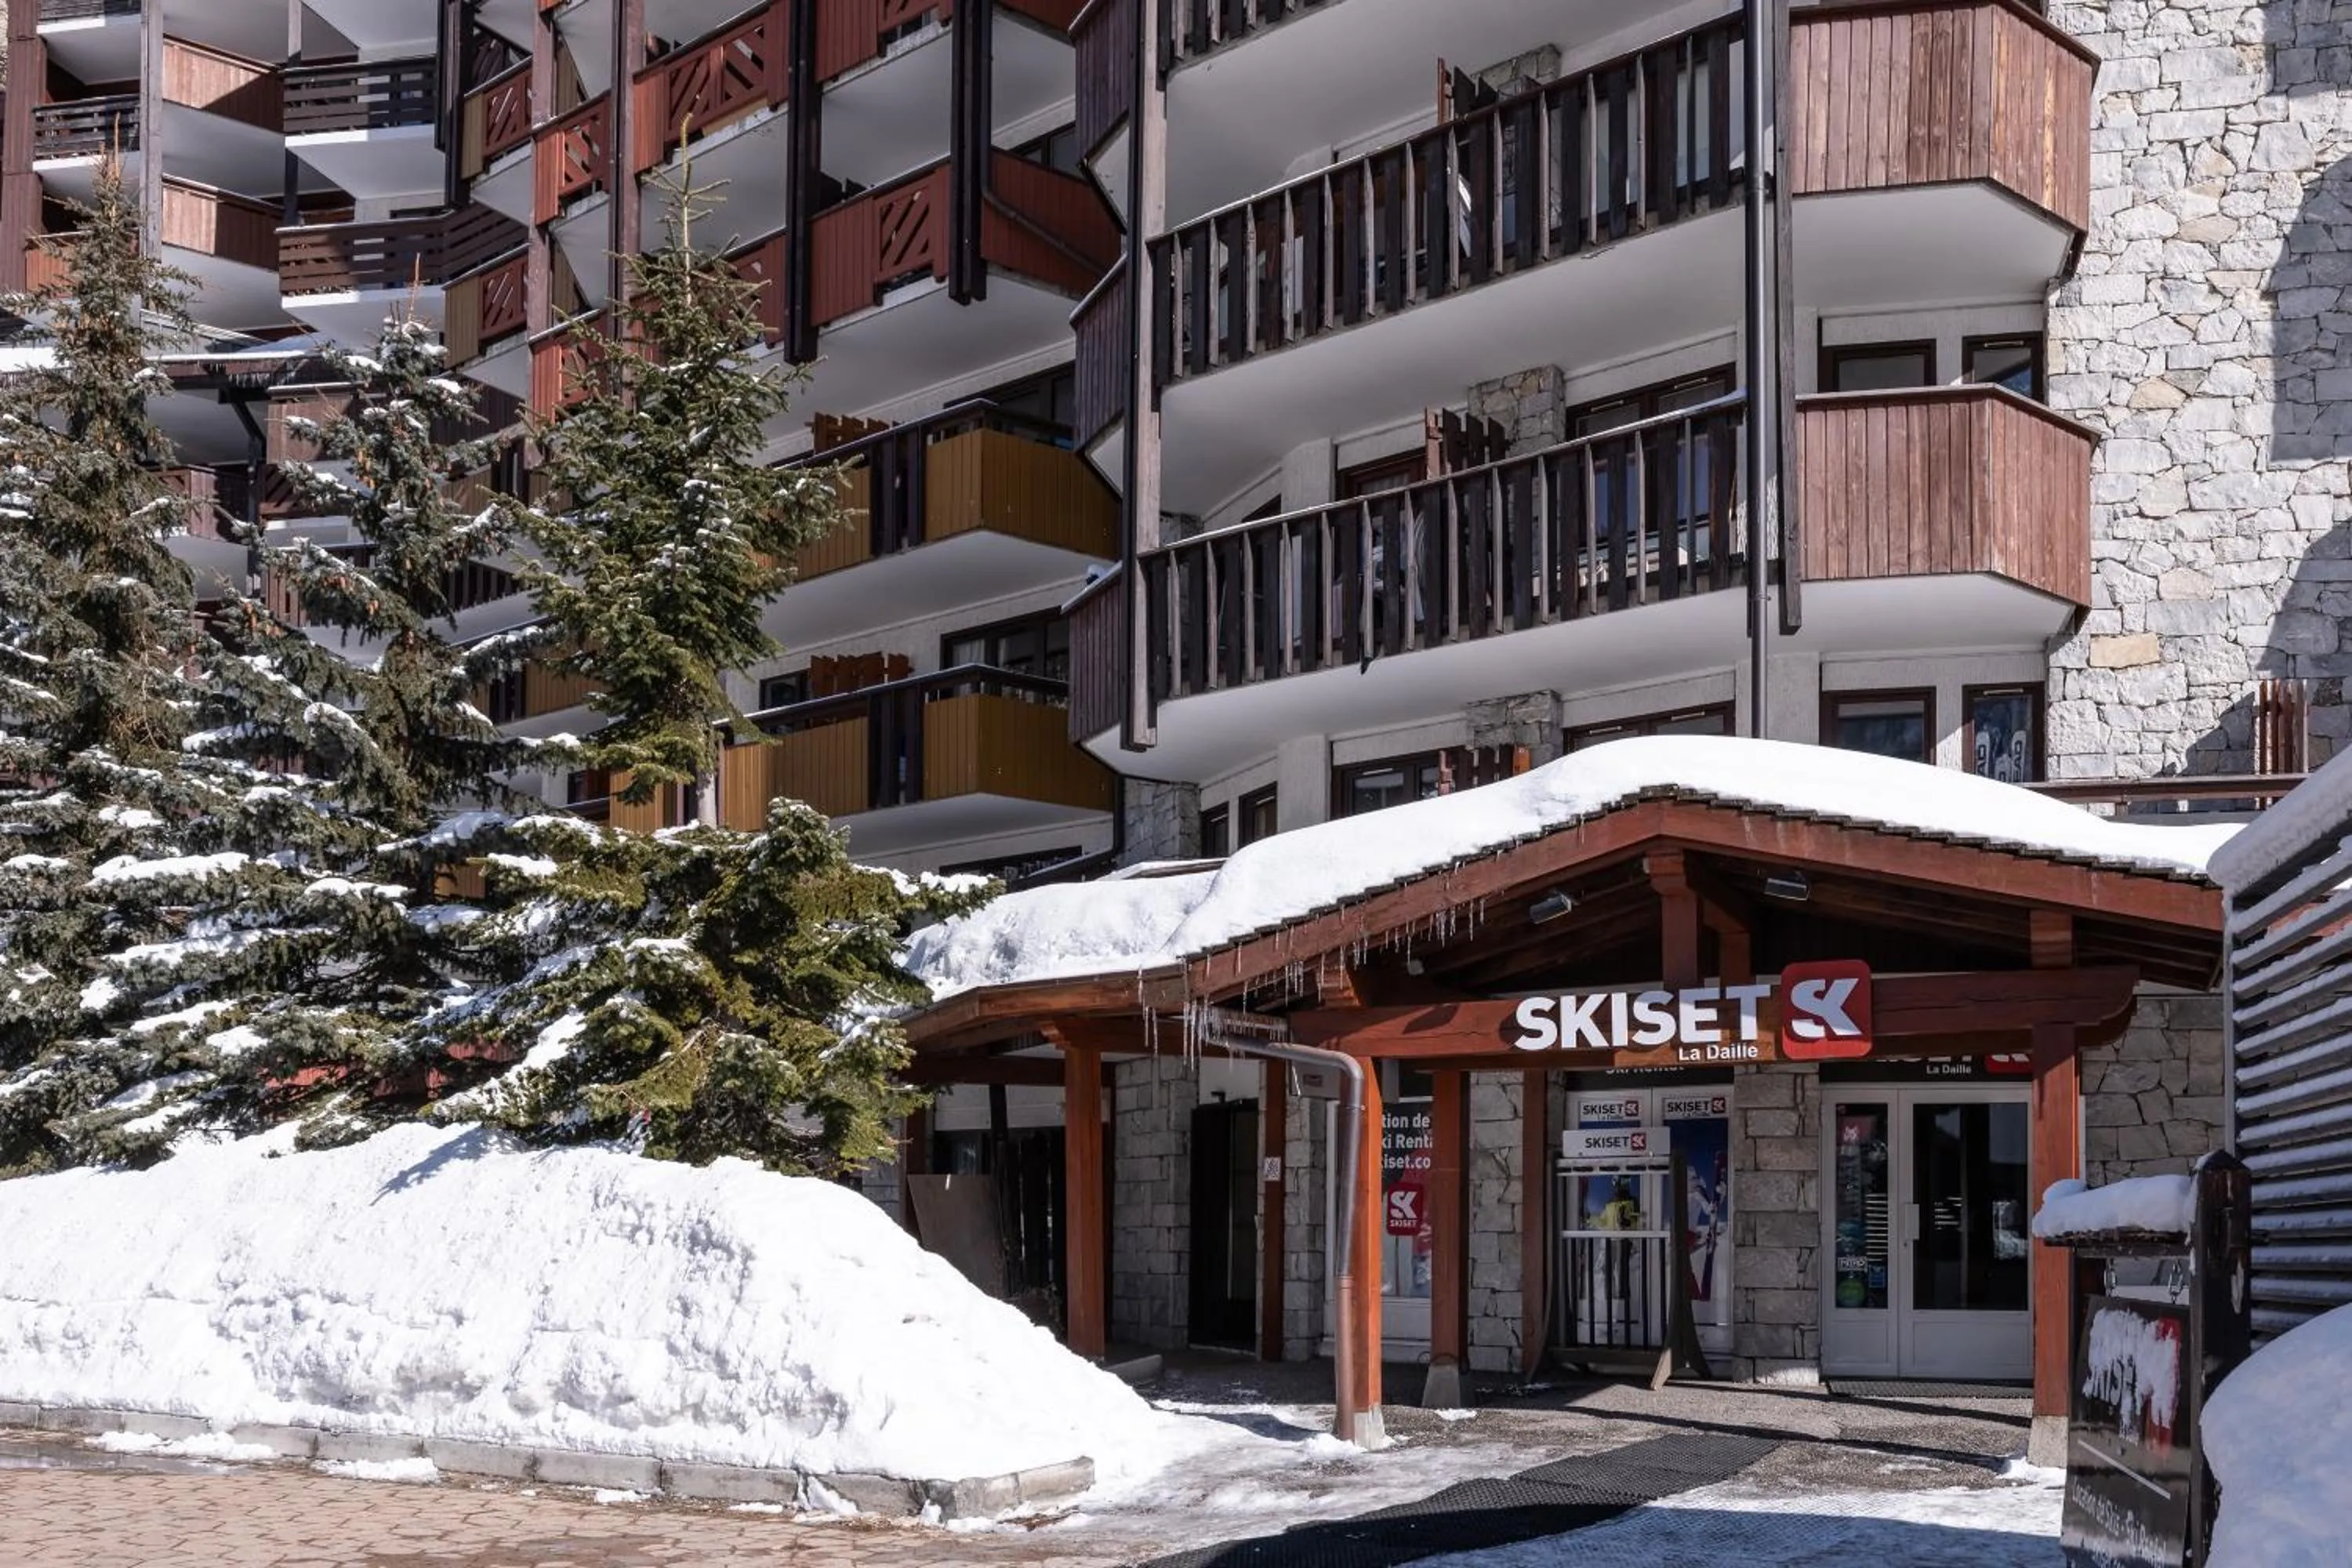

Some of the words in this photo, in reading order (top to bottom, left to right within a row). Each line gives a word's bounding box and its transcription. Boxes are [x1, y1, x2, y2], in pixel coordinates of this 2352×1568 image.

[1514, 984, 1770, 1050] SKISET
[1679, 1047, 1700, 1061] La
[1707, 1044, 1759, 1061] Daille
[1927, 1065, 1940, 1074] La
[1942, 1064, 1972, 1074] Daille
[1584, 1103, 1623, 1115] SKISET
[1668, 1101, 1711, 1112] SKISET
[1382, 1113, 1409, 1127] tion
[1413, 1112, 1430, 1127] de
[1585, 1136, 1630, 1149] SKISET
[1383, 1154, 1431, 1168] iset.co
